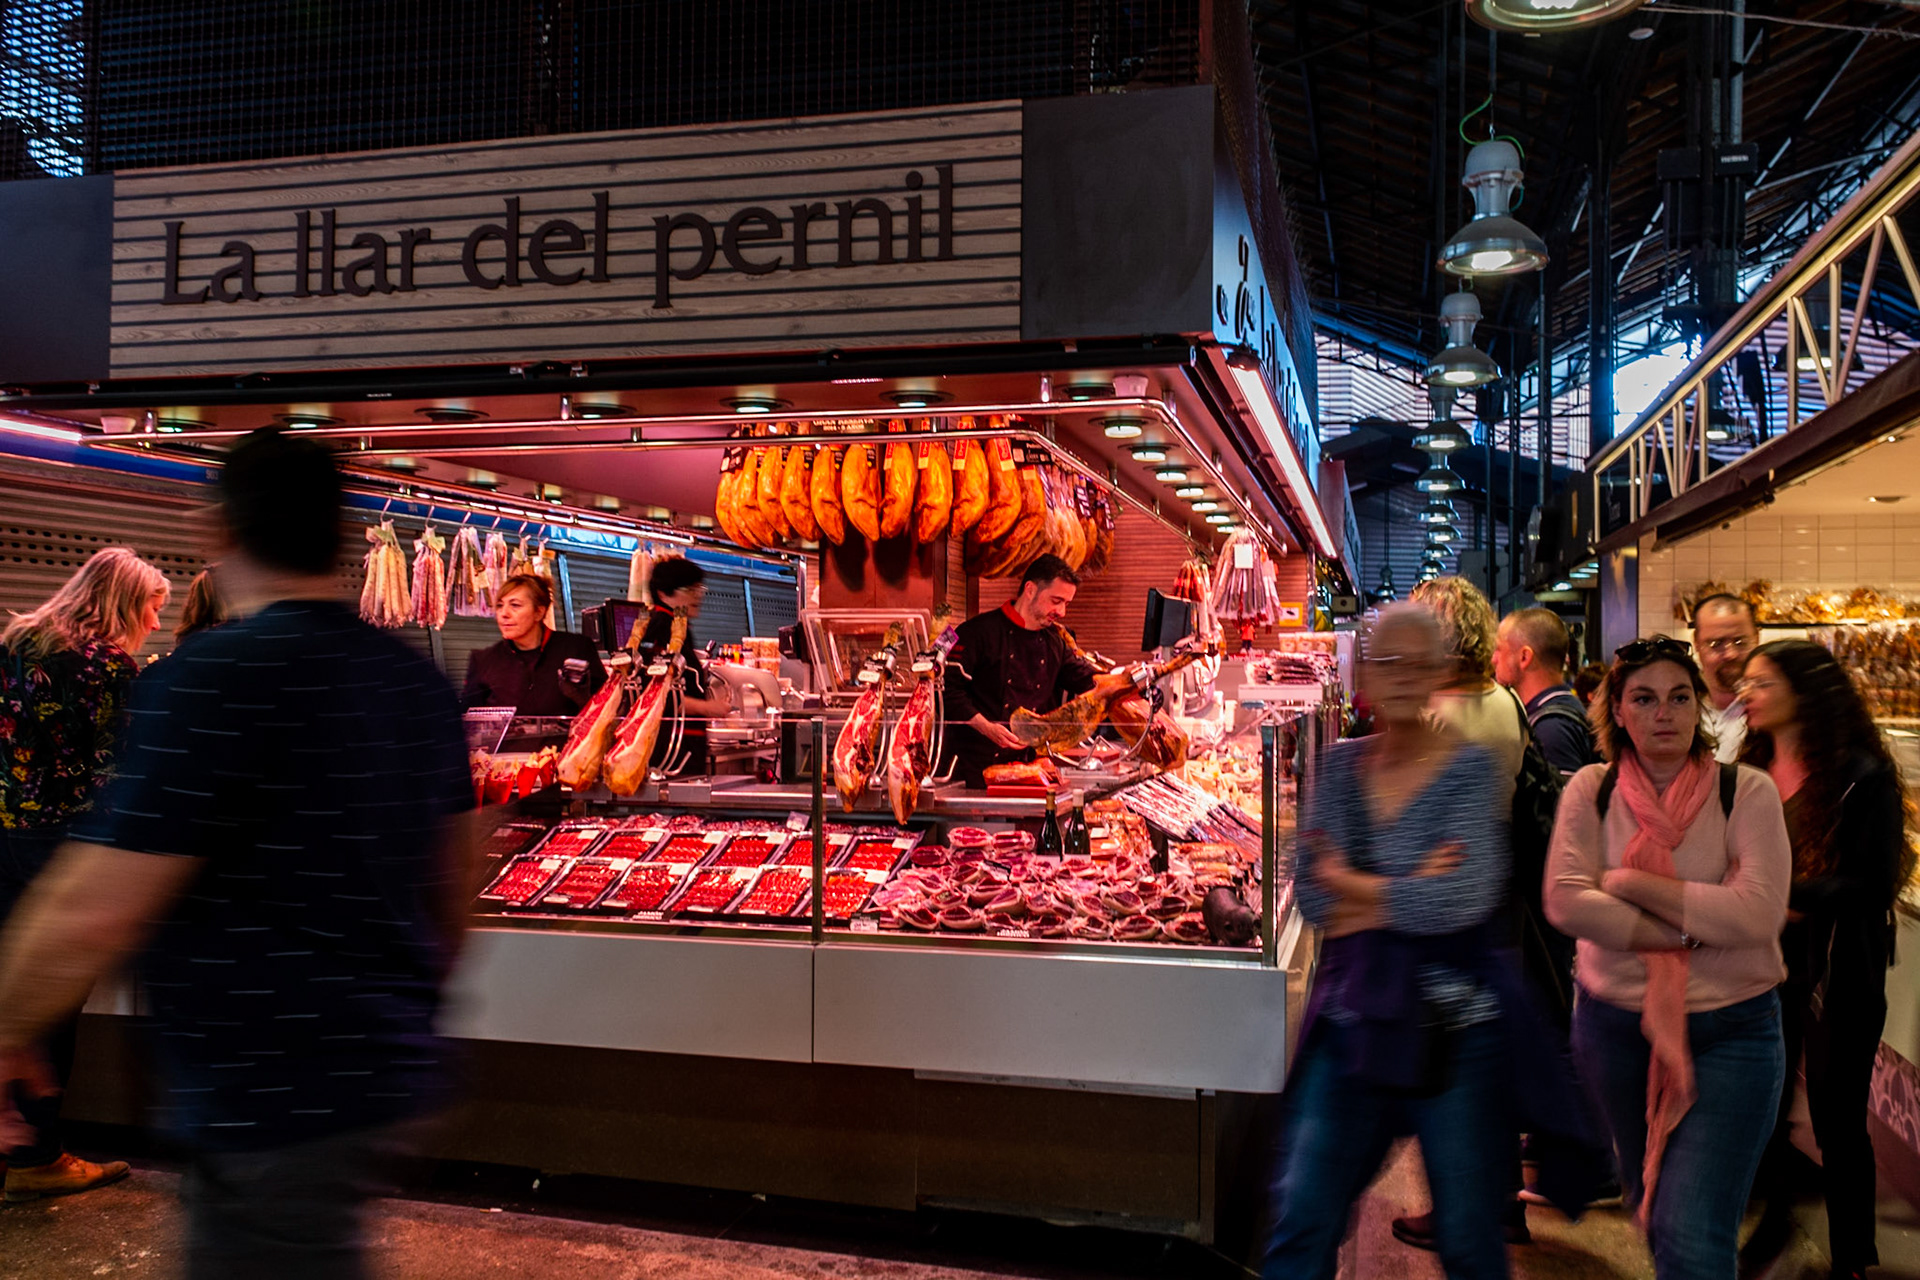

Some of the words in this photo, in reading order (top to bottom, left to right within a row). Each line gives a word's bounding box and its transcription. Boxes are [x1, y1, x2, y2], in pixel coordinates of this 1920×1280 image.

[160, 220, 264, 305] La
[293, 208, 431, 298] llar
[461, 190, 611, 290] del
[652, 163, 958, 309] pernil
